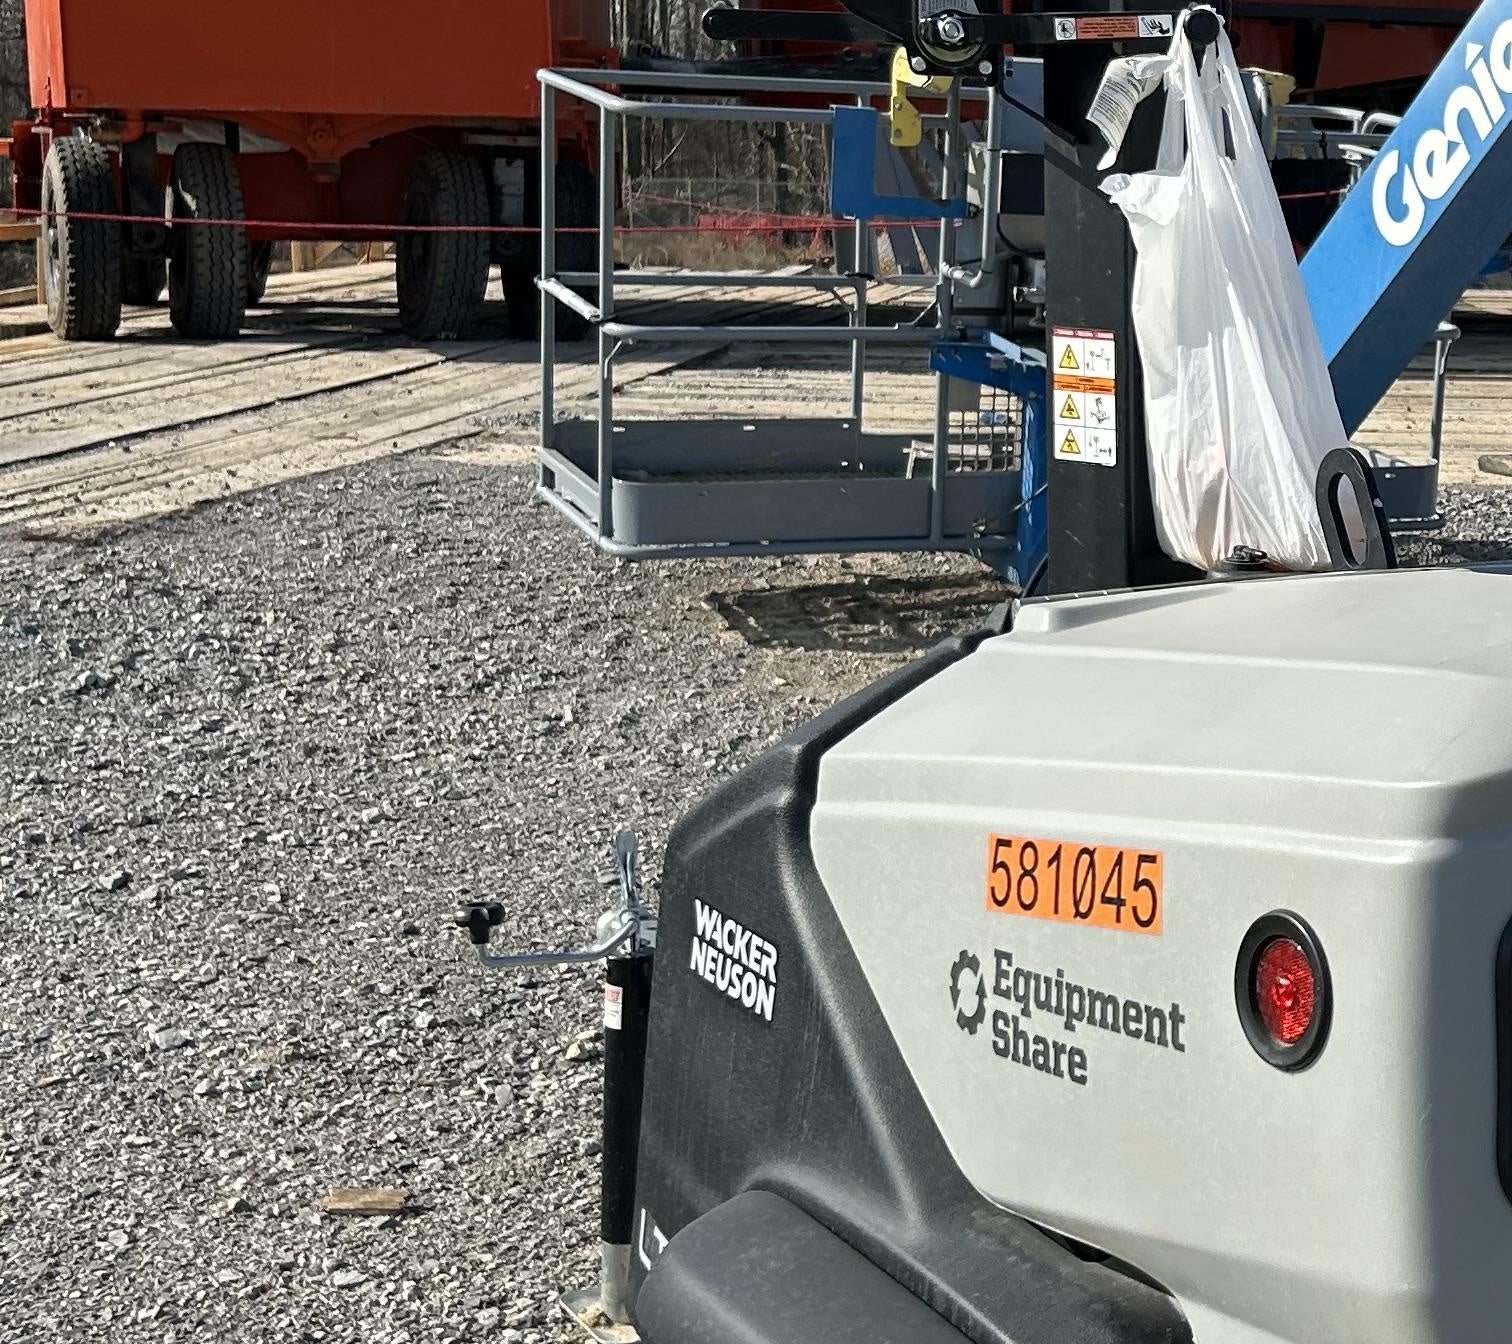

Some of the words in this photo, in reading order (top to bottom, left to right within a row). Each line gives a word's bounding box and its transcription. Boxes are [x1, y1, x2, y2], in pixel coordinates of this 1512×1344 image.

[990, 837, 1158, 928] 581045
[690, 936, 776, 1022] NEUSON
[694, 898, 778, 984] WACKER
[993, 948, 1186, 1053] Equipment
[992, 1008, 1088, 1086] Share
